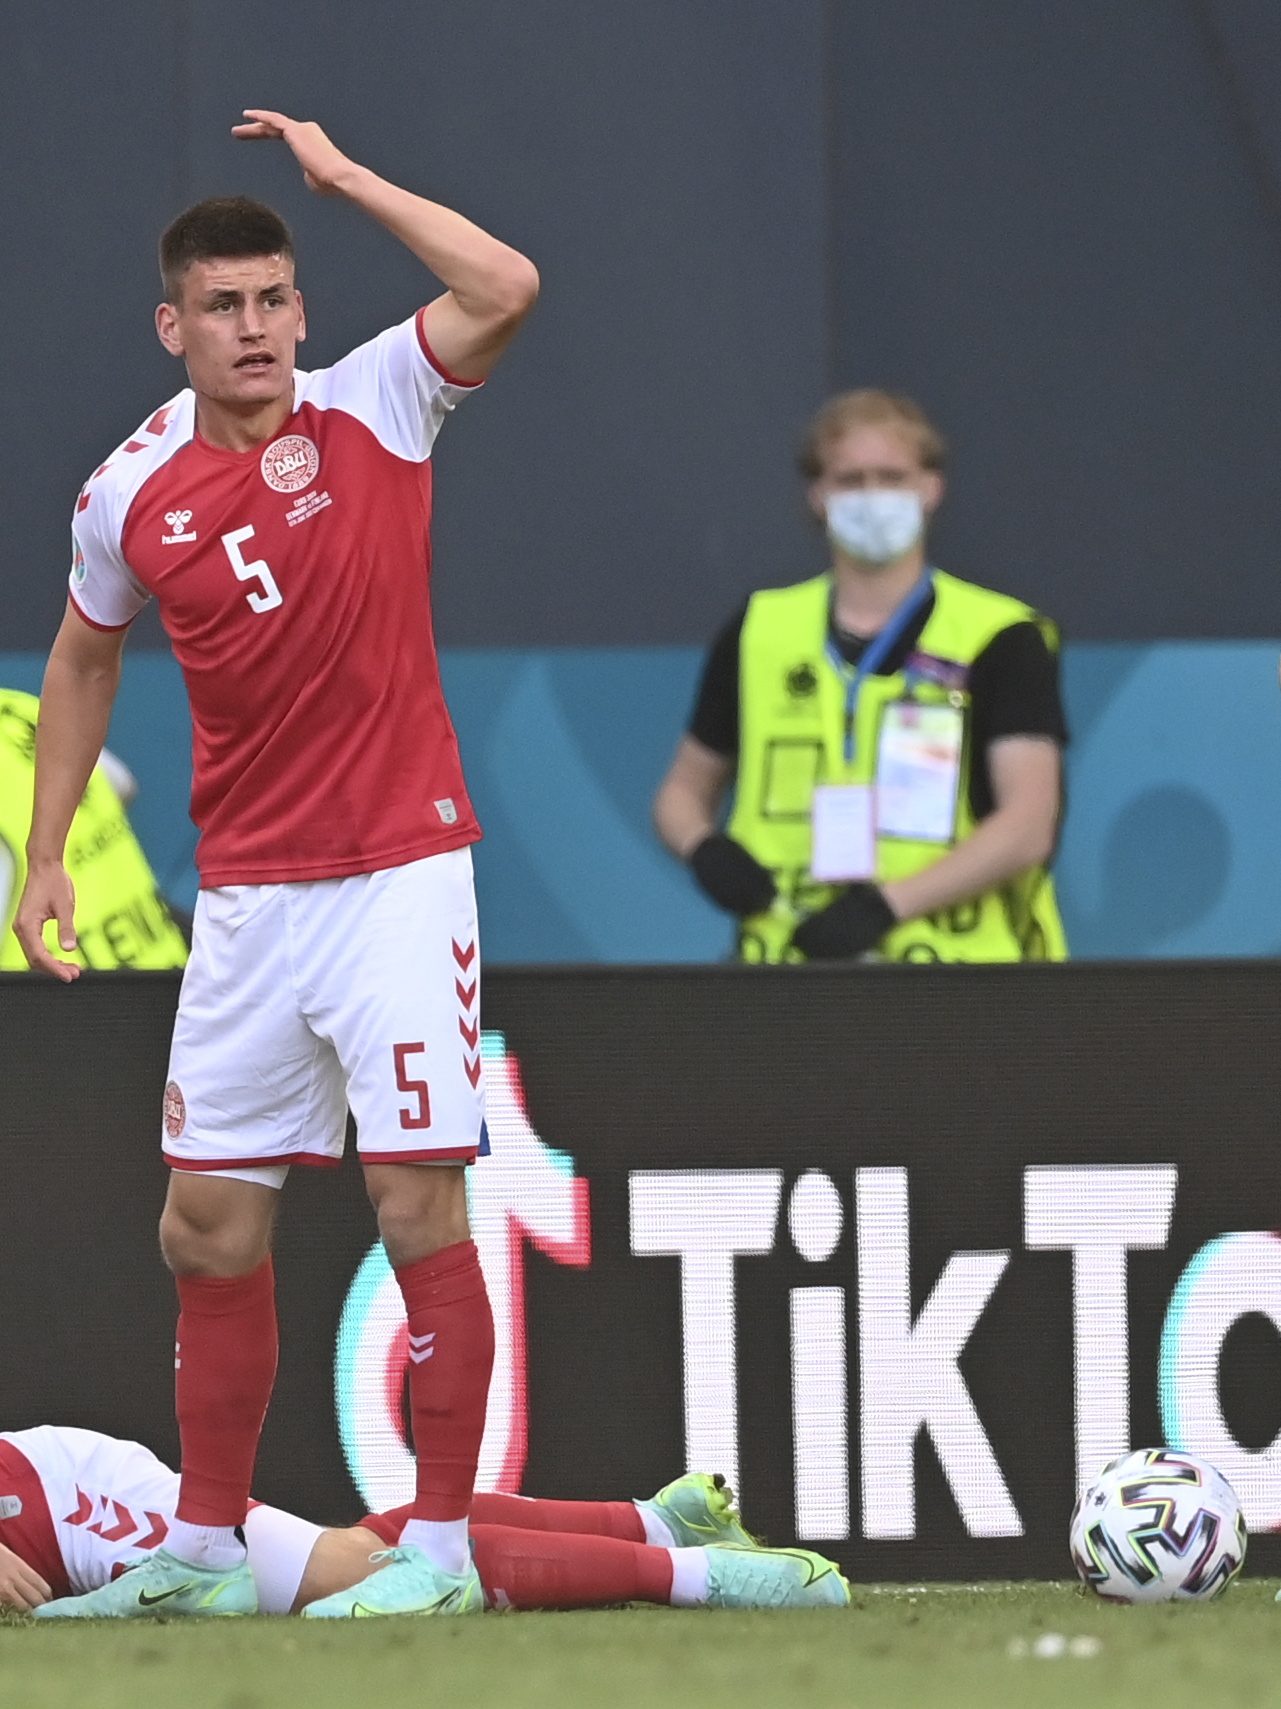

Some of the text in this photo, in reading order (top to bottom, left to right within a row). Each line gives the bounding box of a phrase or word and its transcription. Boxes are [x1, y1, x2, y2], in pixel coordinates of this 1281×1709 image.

[273, 450, 308, 477] DBU
[221, 524, 283, 614] 5
[393, 1041, 432, 1130] 5
